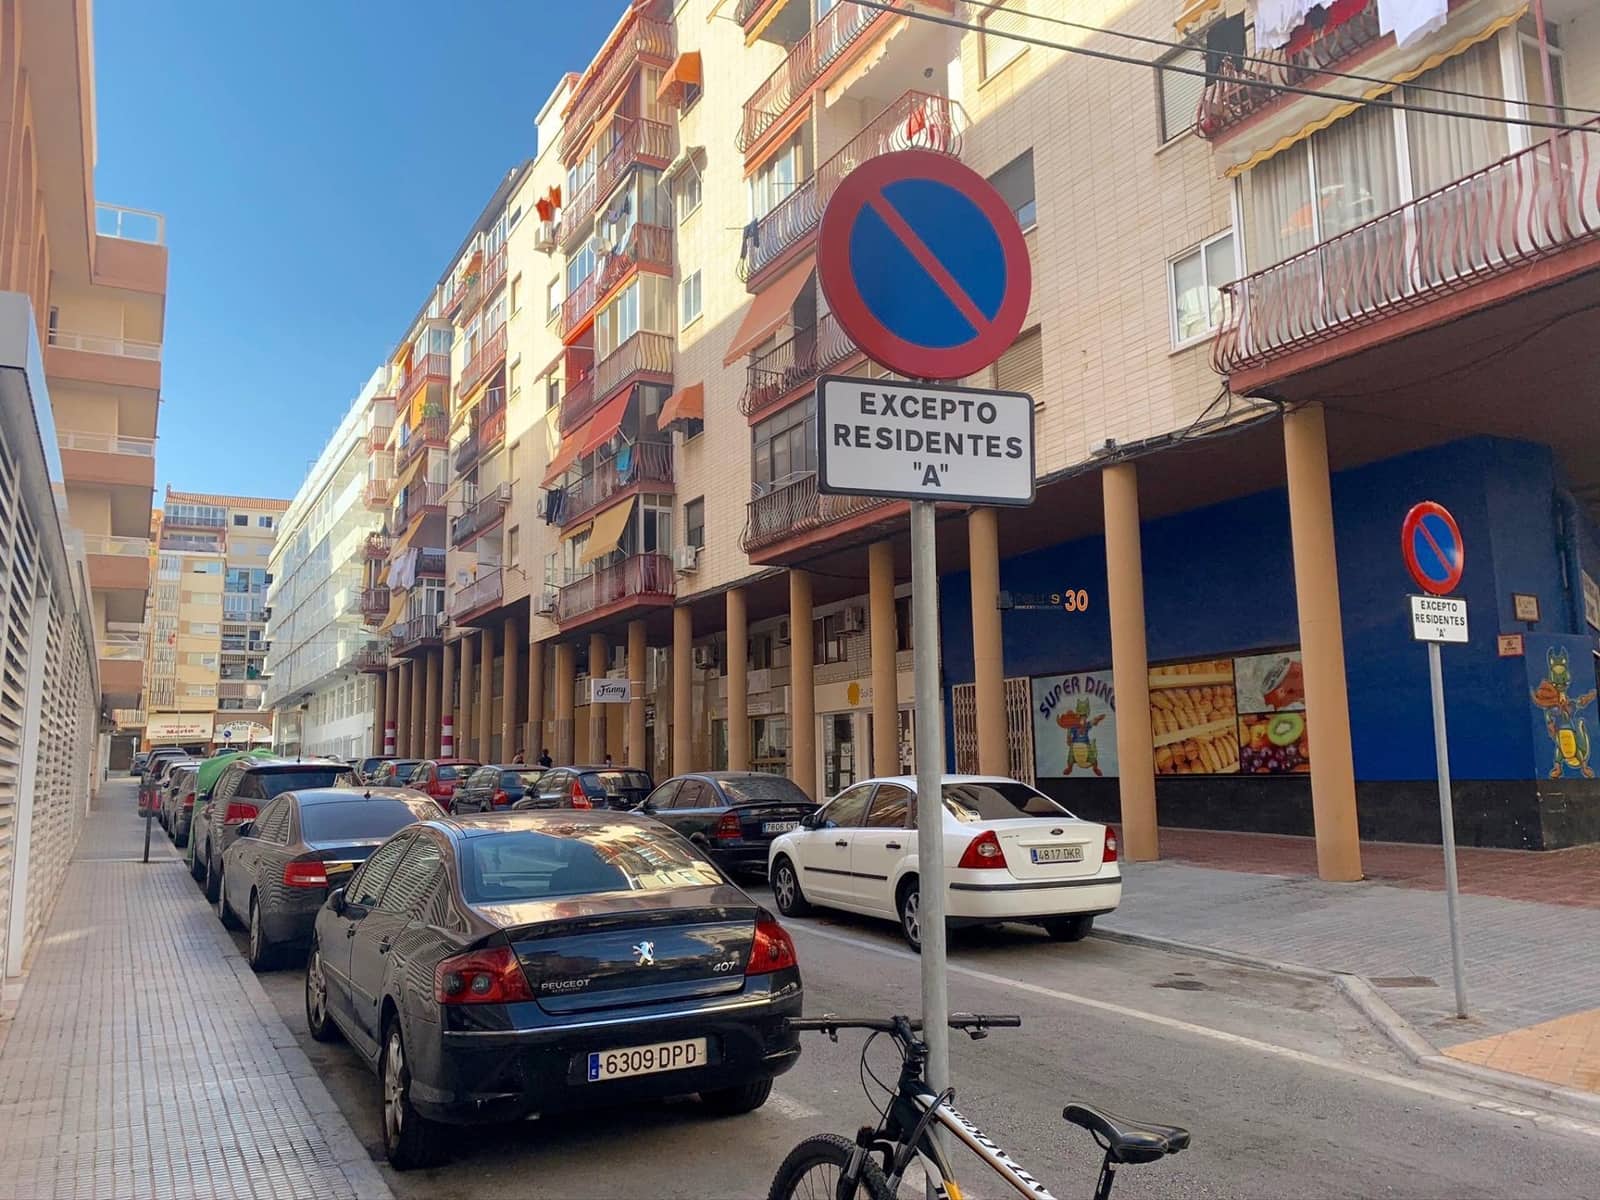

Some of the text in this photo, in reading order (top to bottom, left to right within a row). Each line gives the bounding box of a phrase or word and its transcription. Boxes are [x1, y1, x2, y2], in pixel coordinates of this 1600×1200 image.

[860, 392, 997, 424] EXCEPTO
[833, 423, 1023, 459] RESIDENTES
[913, 462, 949, 487] "A"
[1064, 589, 1089, 612] 30
[1420, 600, 1458, 612] EXCEPTO
[1415, 612, 1465, 626] RESIDENTES
[596, 683, 626, 698] Fanny
[1039, 676, 1081, 720] SUPER
[1039, 848, 1081, 860] 4817 DKR
[712, 961, 736, 972] 407
[541, 978, 591, 991] PEUGEOT
[606, 1043, 696, 1074] 6309 DPD
